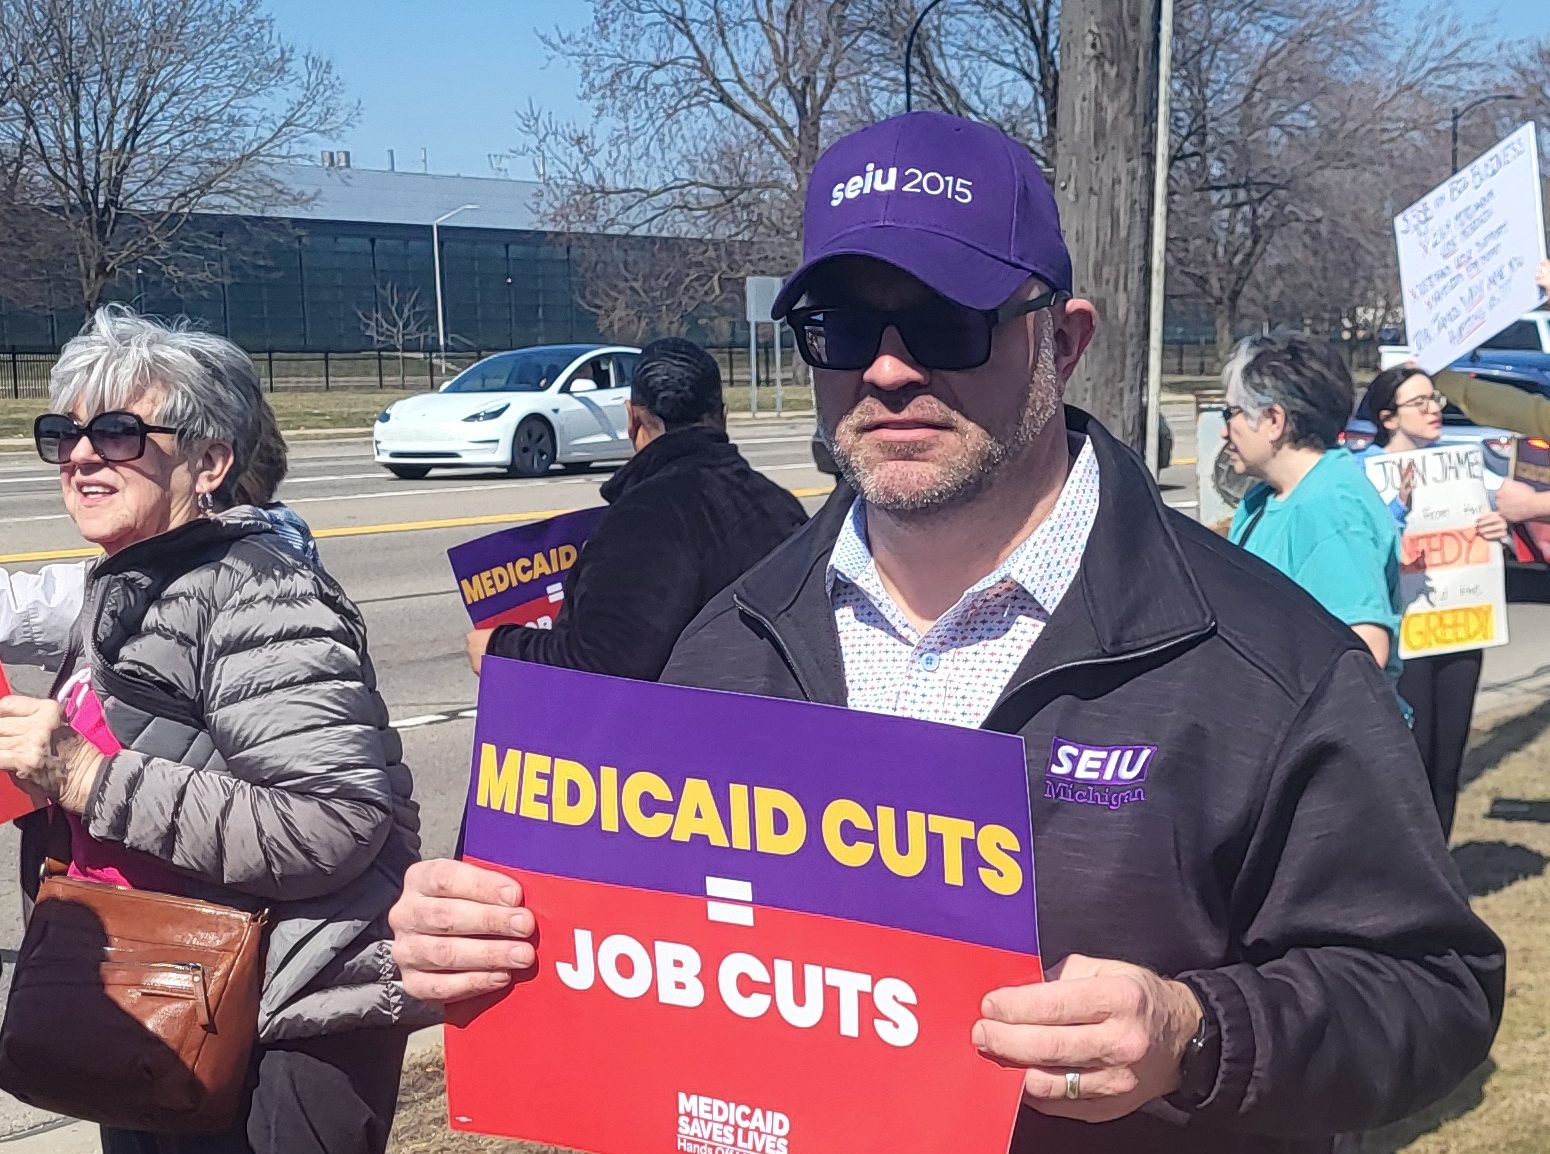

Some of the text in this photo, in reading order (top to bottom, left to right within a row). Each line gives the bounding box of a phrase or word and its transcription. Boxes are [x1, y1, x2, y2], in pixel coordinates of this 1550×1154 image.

[830, 163, 974, 206] seiu 2015
[1432, 450, 1484, 483] JAME
[460, 544, 578, 605] MEDICAID
[1405, 605, 1494, 650] GREEDY
[1050, 745, 1151, 780] SEIU
[1044, 781, 1145, 809] Michigan
[476, 742, 1024, 896] MEDICAID CUTS
[556, 928, 919, 1047] JOB CUTS
[678, 1092, 790, 1136] MEDICAID
[678, 1115, 734, 1145] SAVES
